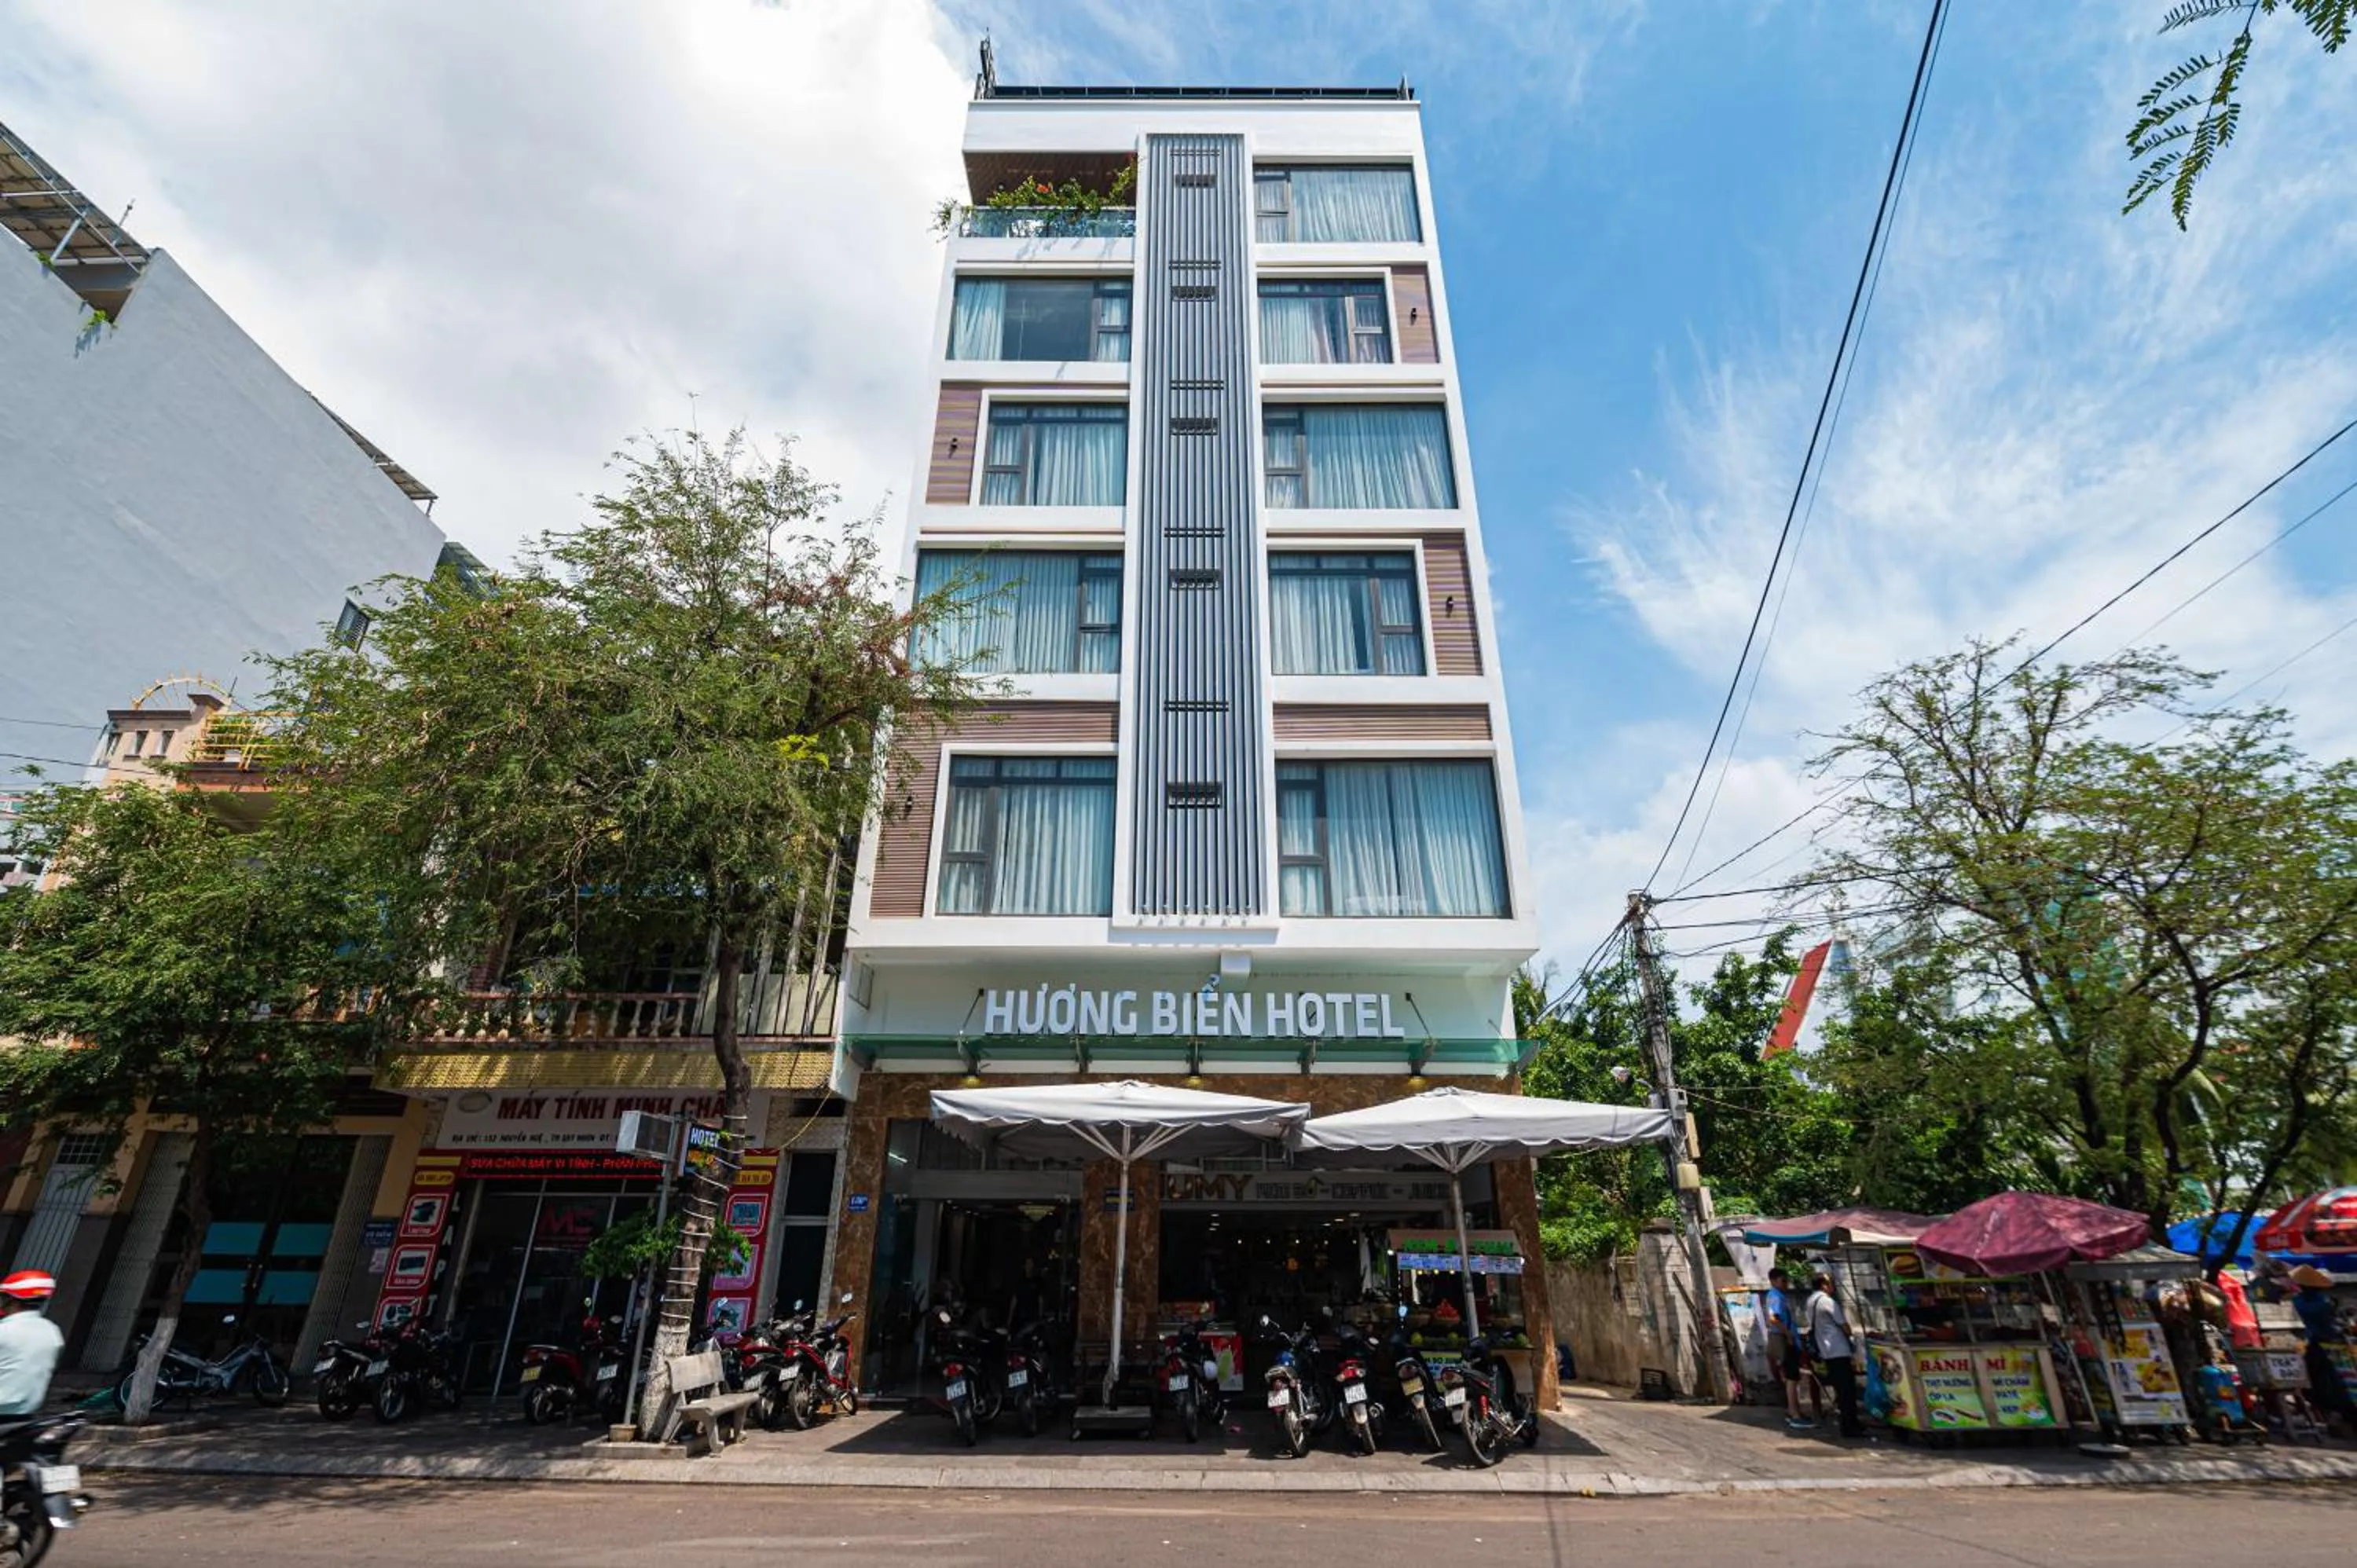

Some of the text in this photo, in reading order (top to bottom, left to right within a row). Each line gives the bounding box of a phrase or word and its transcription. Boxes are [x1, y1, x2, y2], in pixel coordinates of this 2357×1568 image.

[984, 974, 1404, 1037] HƯƠNG BIỂN HOTEL
[497, 1090, 548, 1119] MÁY
[555, 1090, 607, 1119] TÍNH
[681, 1090, 726, 1118] CHÂ
